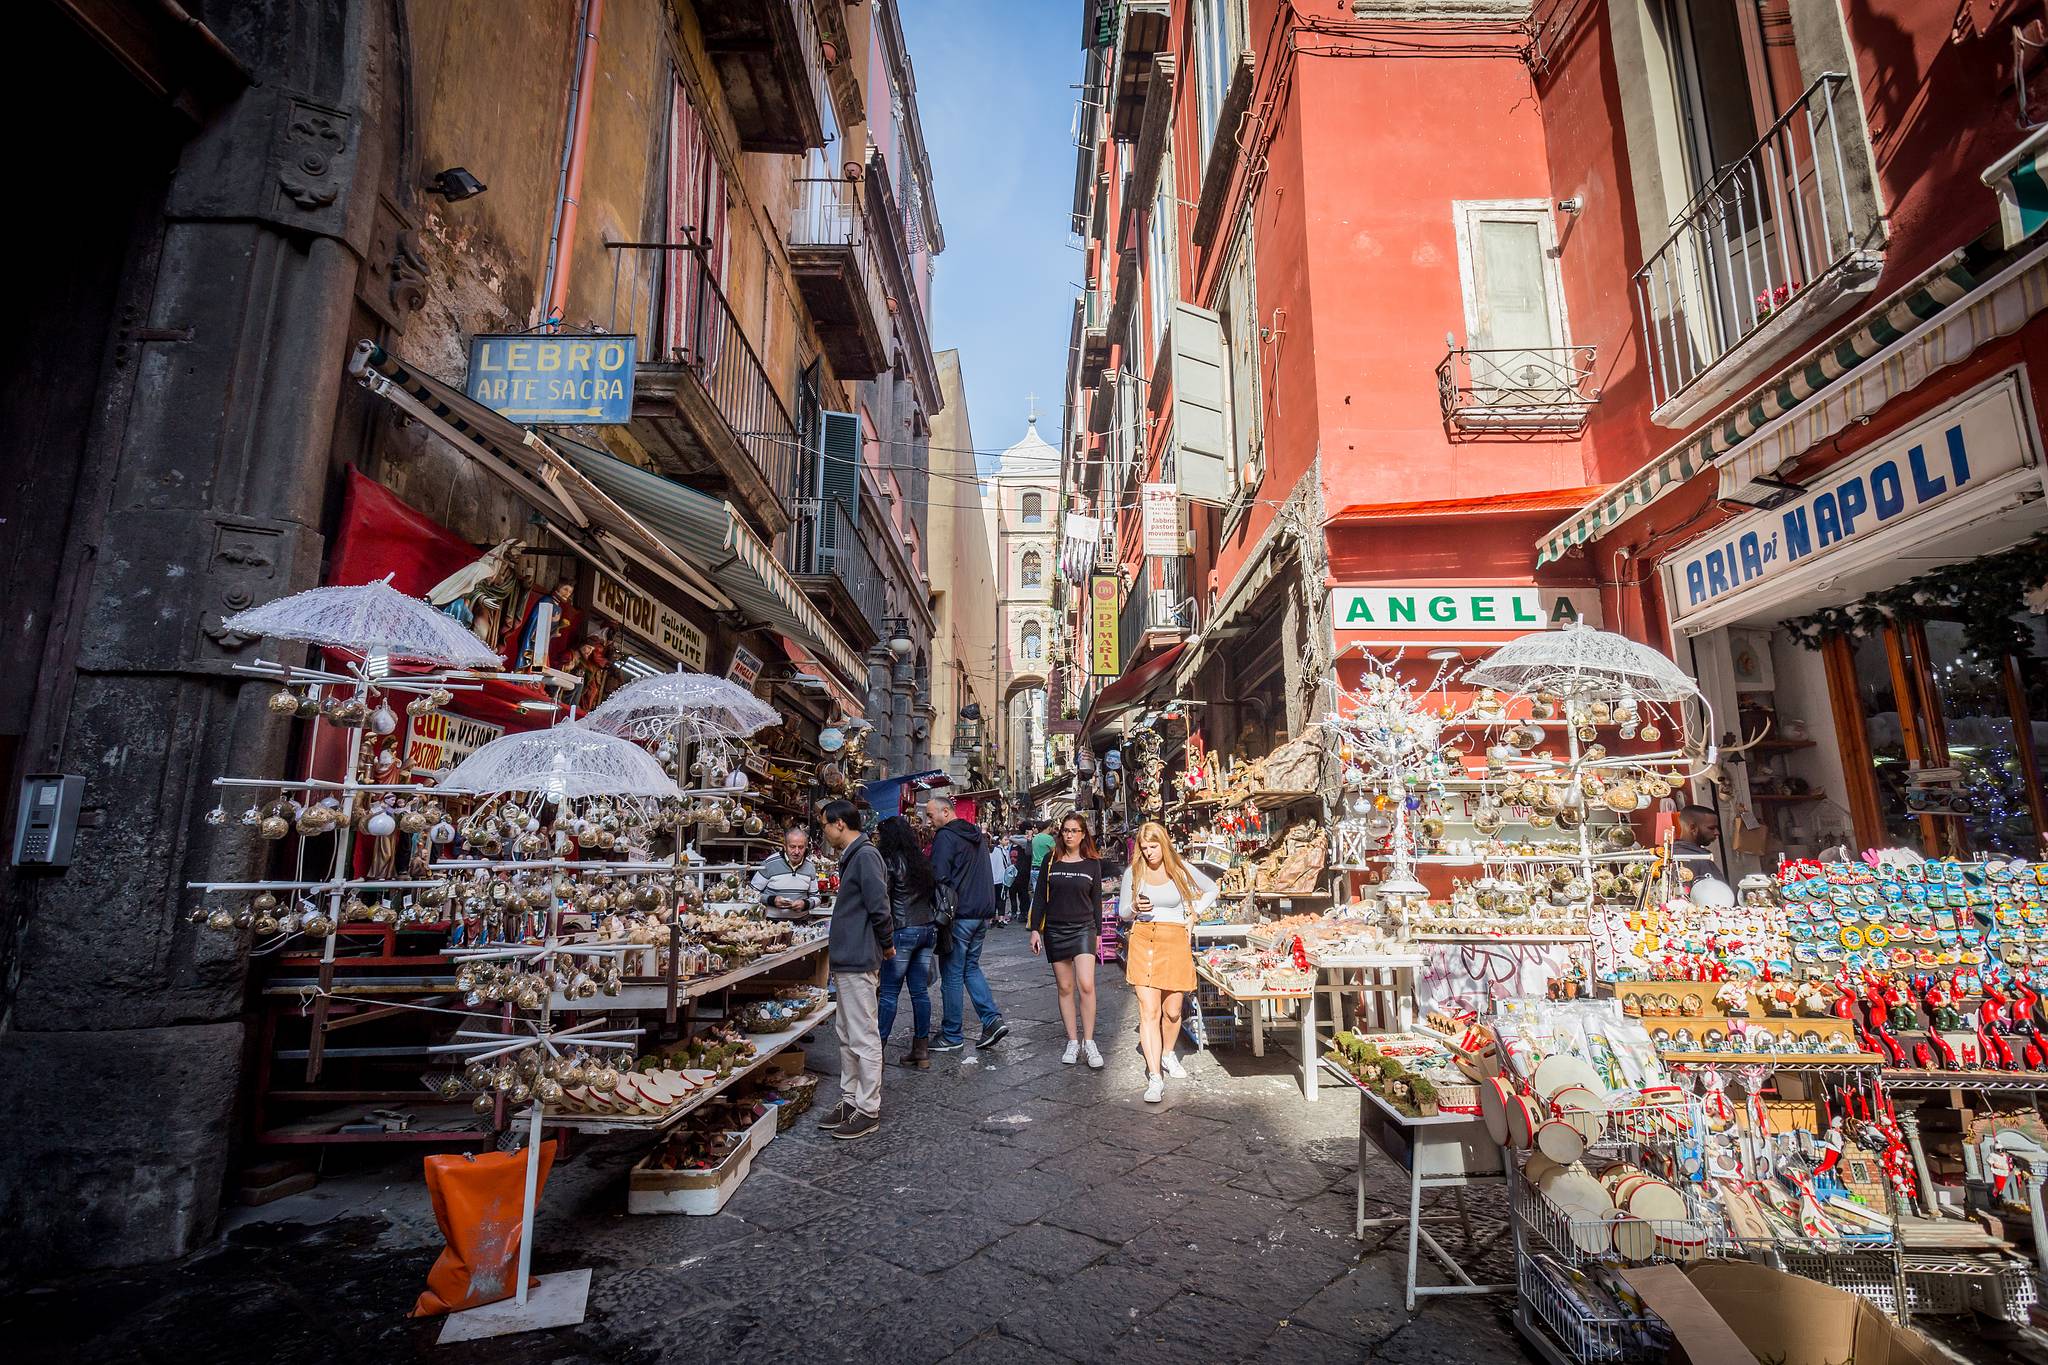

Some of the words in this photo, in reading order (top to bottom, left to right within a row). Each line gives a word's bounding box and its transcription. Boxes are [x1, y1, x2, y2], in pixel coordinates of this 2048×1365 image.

[480, 343, 625, 371] LEBRO
[477, 378, 539, 400] ARTE
[548, 379, 624, 400] SACRA
[1686, 530, 1763, 606] ARIA
[1782, 424, 1971, 563] NAPOLI
[597, 576, 657, 636] PASTORI
[1099, 613, 1112, 628] DE
[1345, 596, 1579, 622] ANGELA
[661, 612, 679, 633] dalle
[679, 623, 700, 647] MANI
[663, 630, 701, 665] PULITE
[1098, 632, 1113, 669] MARIA
[413, 713, 447, 741] QUI
[446, 721, 456, 742] in
[408, 740, 443, 771] PASTORI
